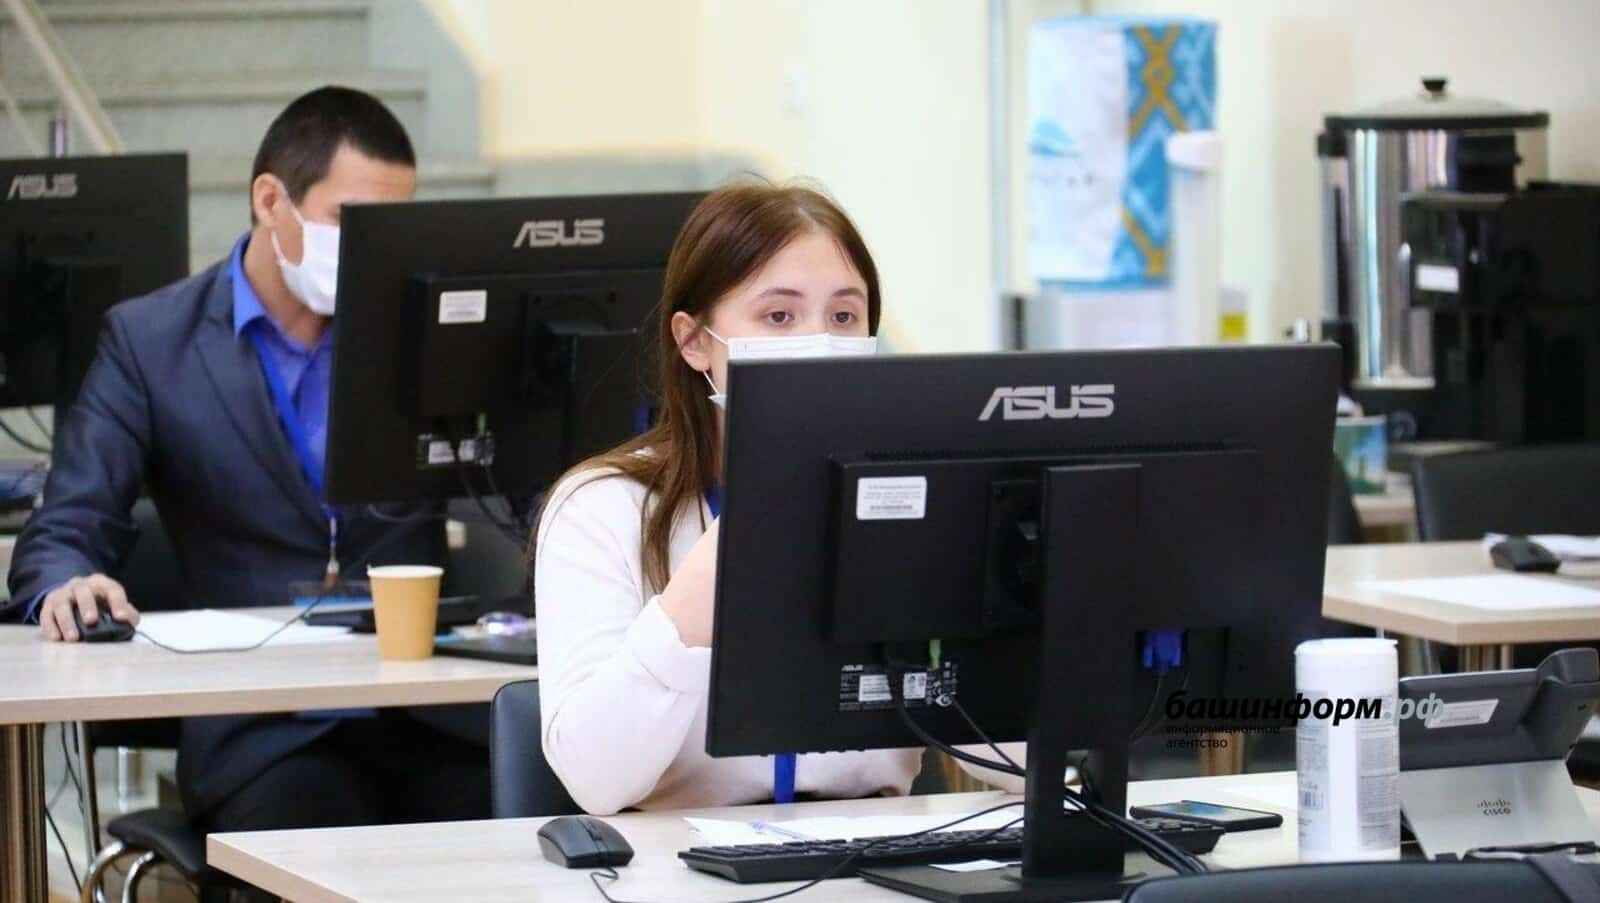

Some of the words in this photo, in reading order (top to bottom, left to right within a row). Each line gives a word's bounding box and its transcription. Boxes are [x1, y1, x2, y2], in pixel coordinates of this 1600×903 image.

[7, 174, 78, 200] ASUS
[513, 219, 605, 248] ASUS
[978, 384, 1115, 421] ASUS
